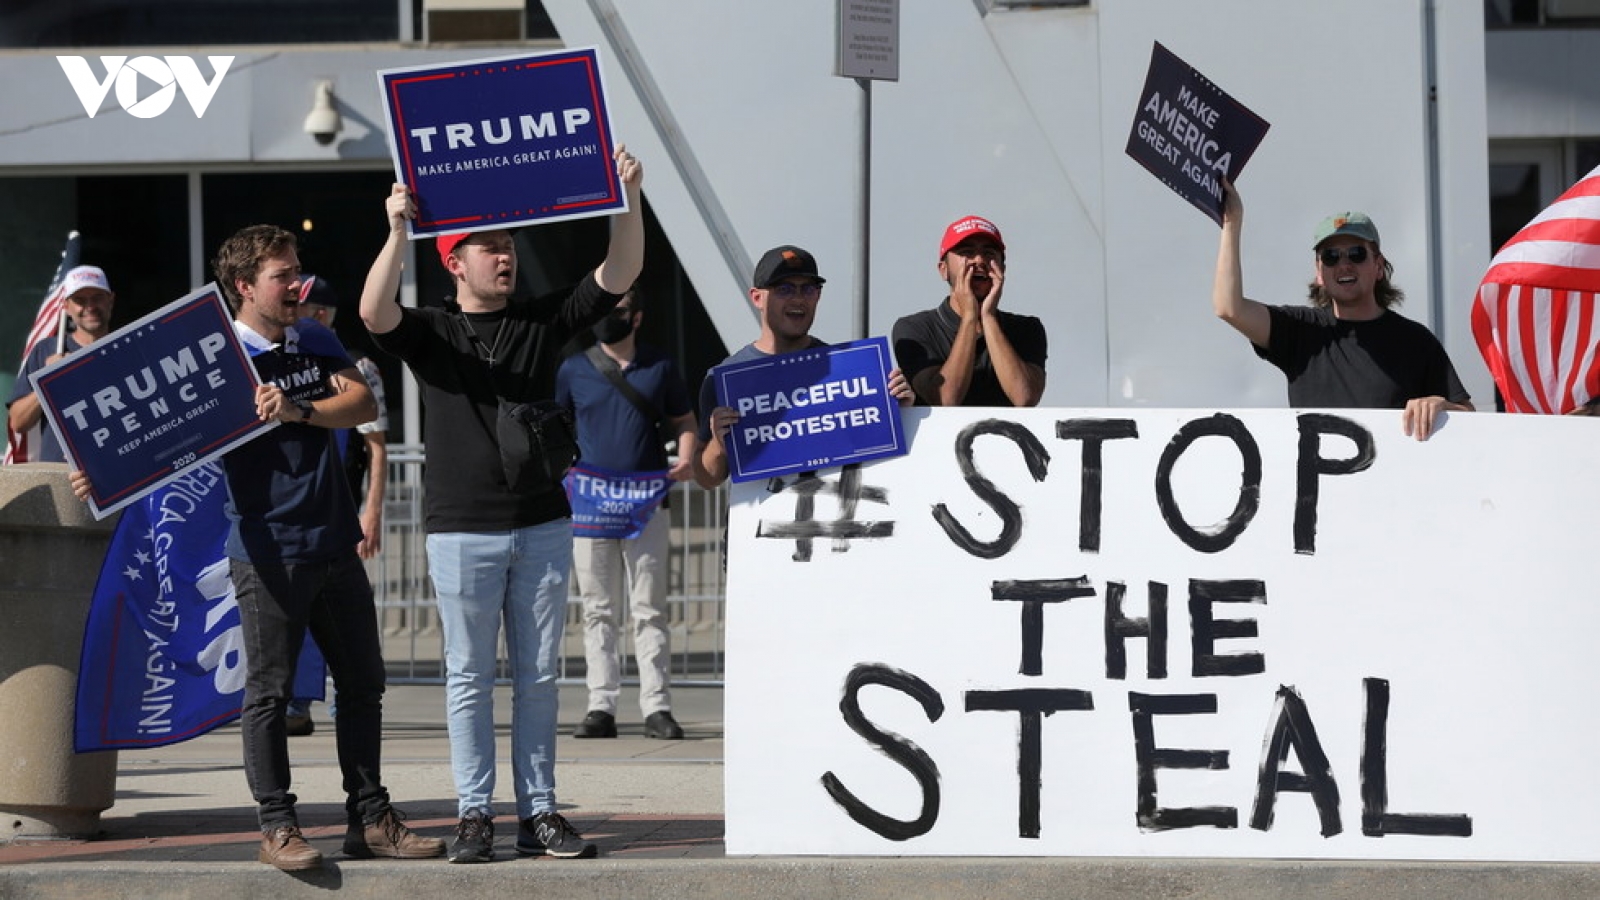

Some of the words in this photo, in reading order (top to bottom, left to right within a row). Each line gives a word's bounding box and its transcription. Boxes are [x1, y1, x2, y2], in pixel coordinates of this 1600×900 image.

[411, 107, 591, 152] TRUMP
[1177, 85, 1220, 129] MAKE
[1138, 121, 1181, 165] GREAT
[1144, 91, 1231, 175] AMERICA
[418, 163, 452, 176] MAKE
[455, 156, 510, 171] AMERICA
[513, 150, 551, 164] GREAT
[554, 145, 597, 159] AGAIN!
[62, 332, 226, 431] TRUMP
[737, 376, 878, 417] PEACEFUL
[92, 368, 227, 448] PENCE
[117, 437, 141, 456] KEEP
[144, 415, 185, 443] AMERICA
[186, 398, 220, 421] GREAT!
[744, 406, 880, 445] PROTESTER
[173, 451, 197, 471] 2020
[807, 457, 830, 467] 2020
[576, 474, 665, 499] TRUMP
[149, 531, 180, 632] GREAT
[990, 575, 1268, 680] THE
[137, 629, 177, 734] AGAIN!
[821, 661, 1472, 841] STEAL
